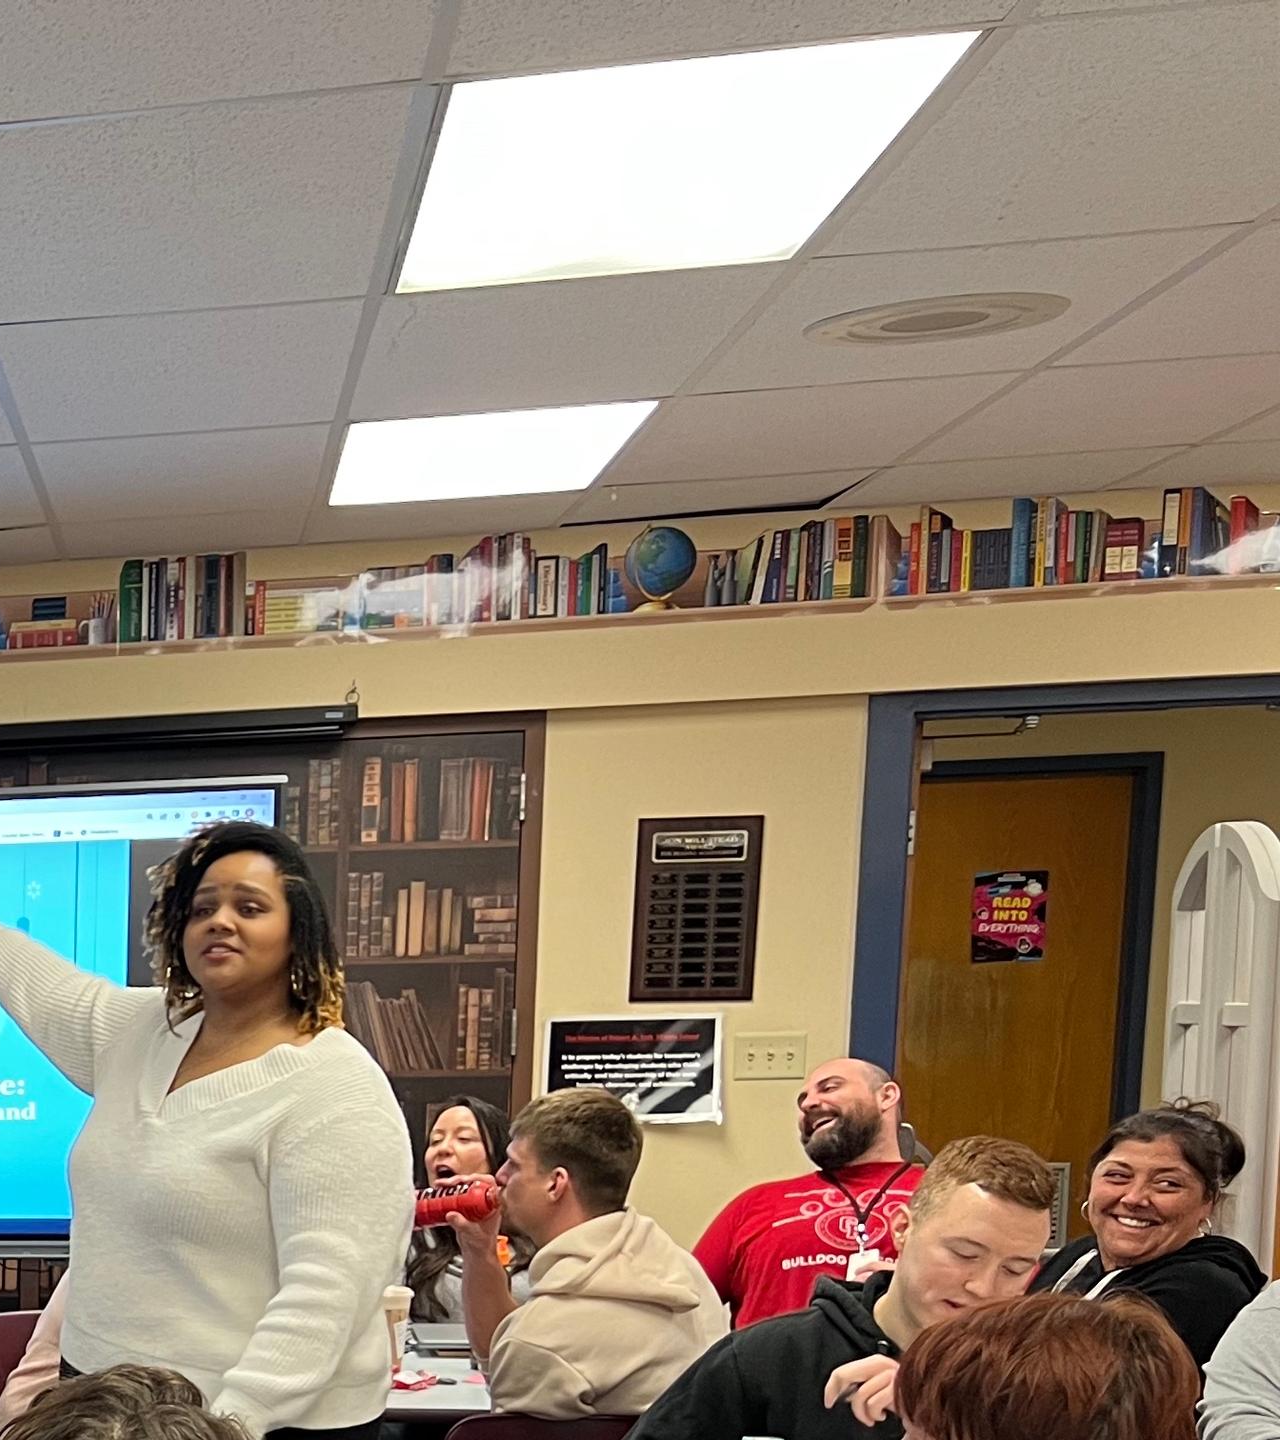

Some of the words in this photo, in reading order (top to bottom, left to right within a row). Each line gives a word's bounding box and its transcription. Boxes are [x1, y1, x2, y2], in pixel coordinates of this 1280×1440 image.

[992, 896, 1032, 908] READ
[992, 910, 1029, 921] INTO
[978, 922, 1041, 934] EVERYTHING
[782, 1254, 847, 1270] BULLDOG
